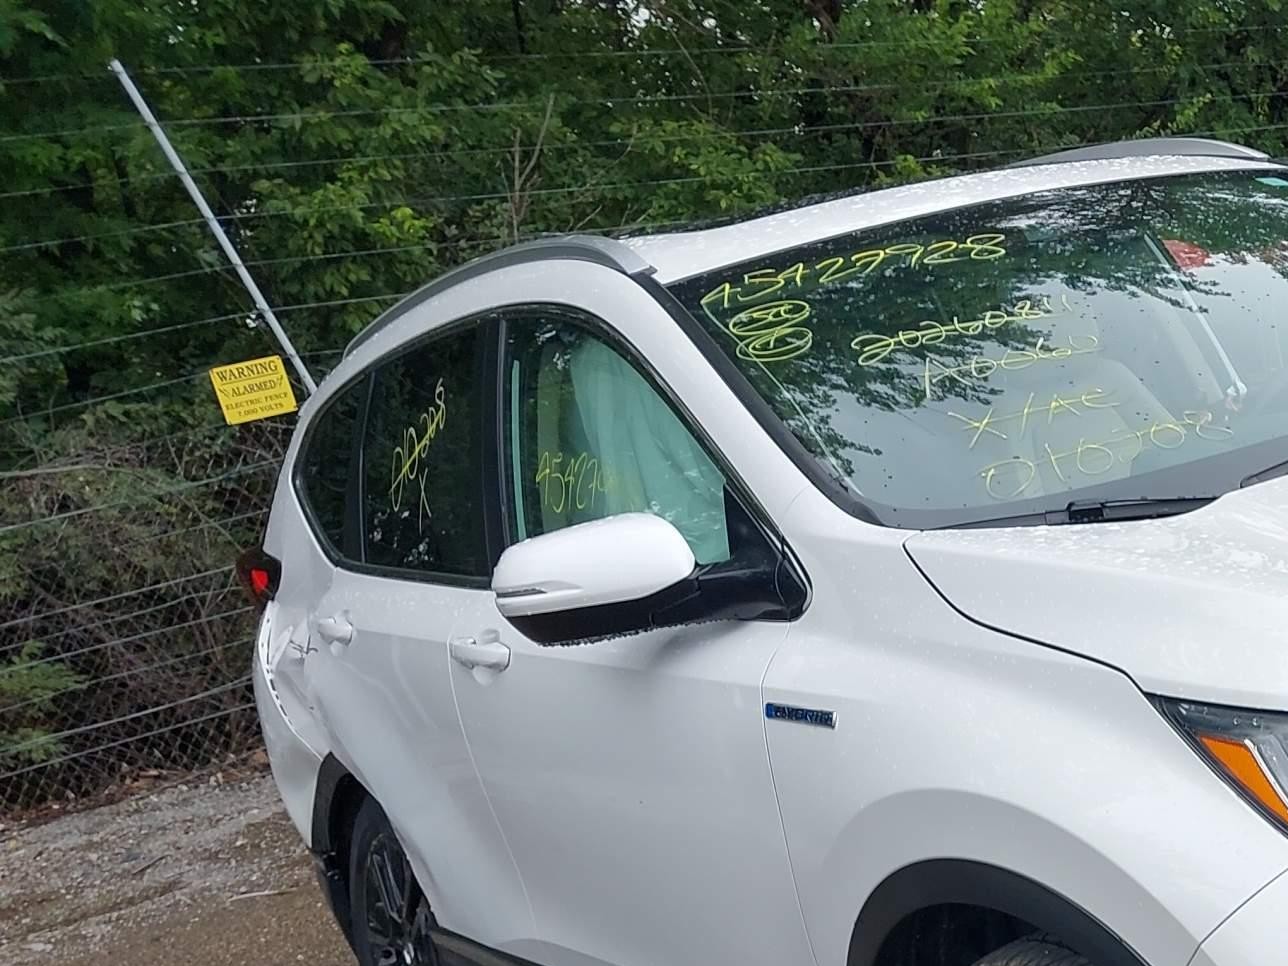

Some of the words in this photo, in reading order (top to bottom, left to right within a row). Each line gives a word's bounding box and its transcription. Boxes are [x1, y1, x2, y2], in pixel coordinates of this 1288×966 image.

[700, 234, 1006, 309] 45427928
[216, 360, 278, 382] WARNING
[231, 379, 277, 397] ALARMED
